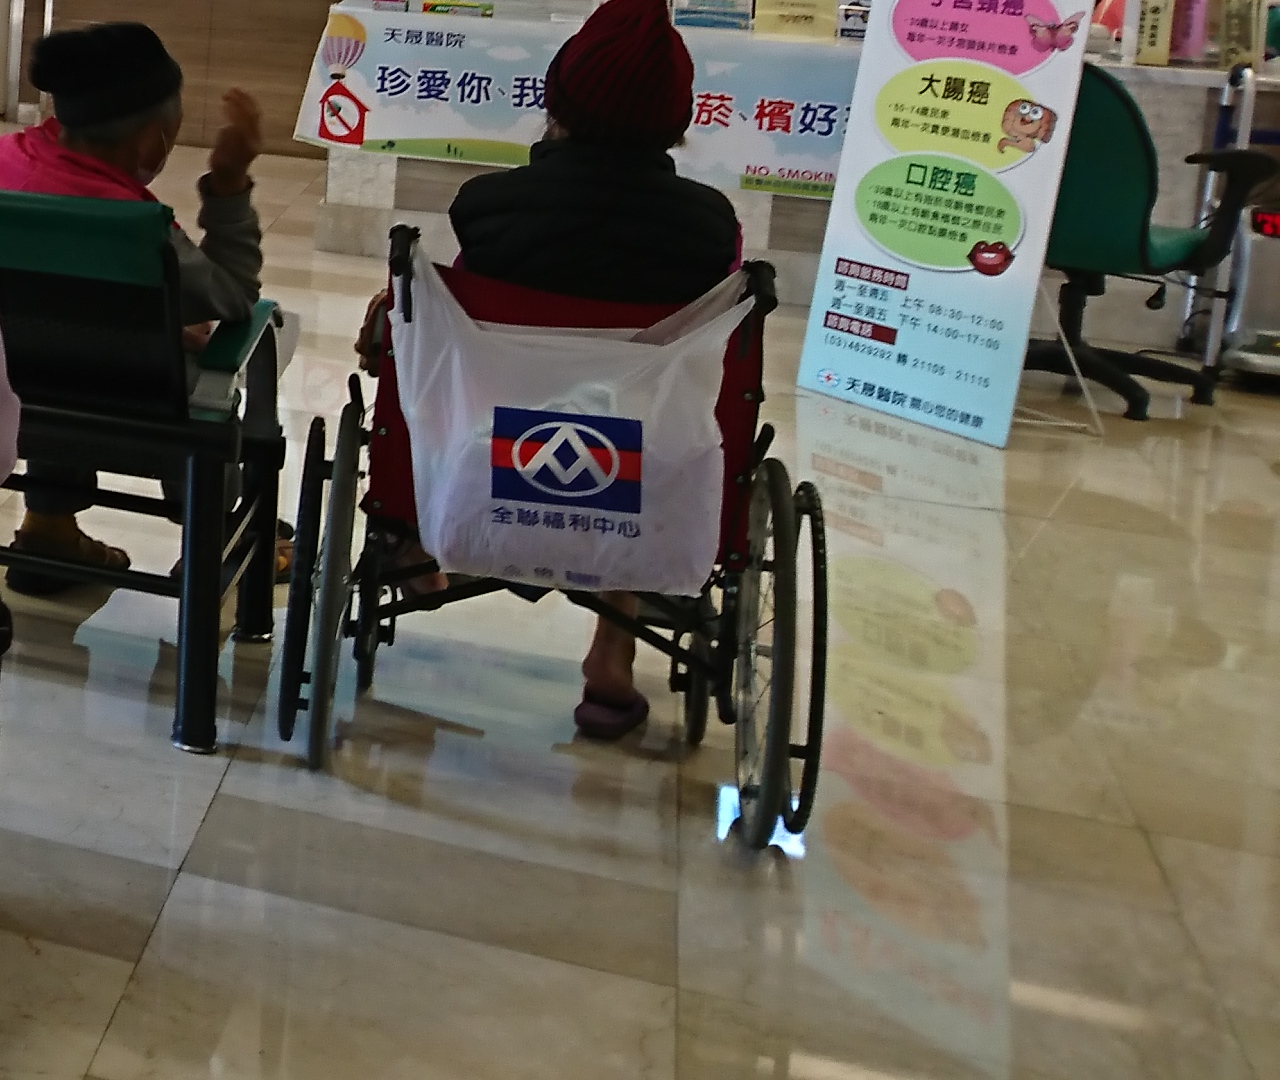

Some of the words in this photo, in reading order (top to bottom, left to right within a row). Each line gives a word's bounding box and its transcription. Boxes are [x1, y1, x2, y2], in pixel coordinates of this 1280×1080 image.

[384, 27, 465, 49] 天晟醫院
[376, 65, 546, 110] 珍愛你、我
[693, 93, 851, 137] 菸、檳好
[918, 73, 991, 105] 大腸癌
[745, 165, 770, 177] NO
[906, 163, 978, 197] 口腔癌
[492, 506, 641, 539] 全聯福利中心
